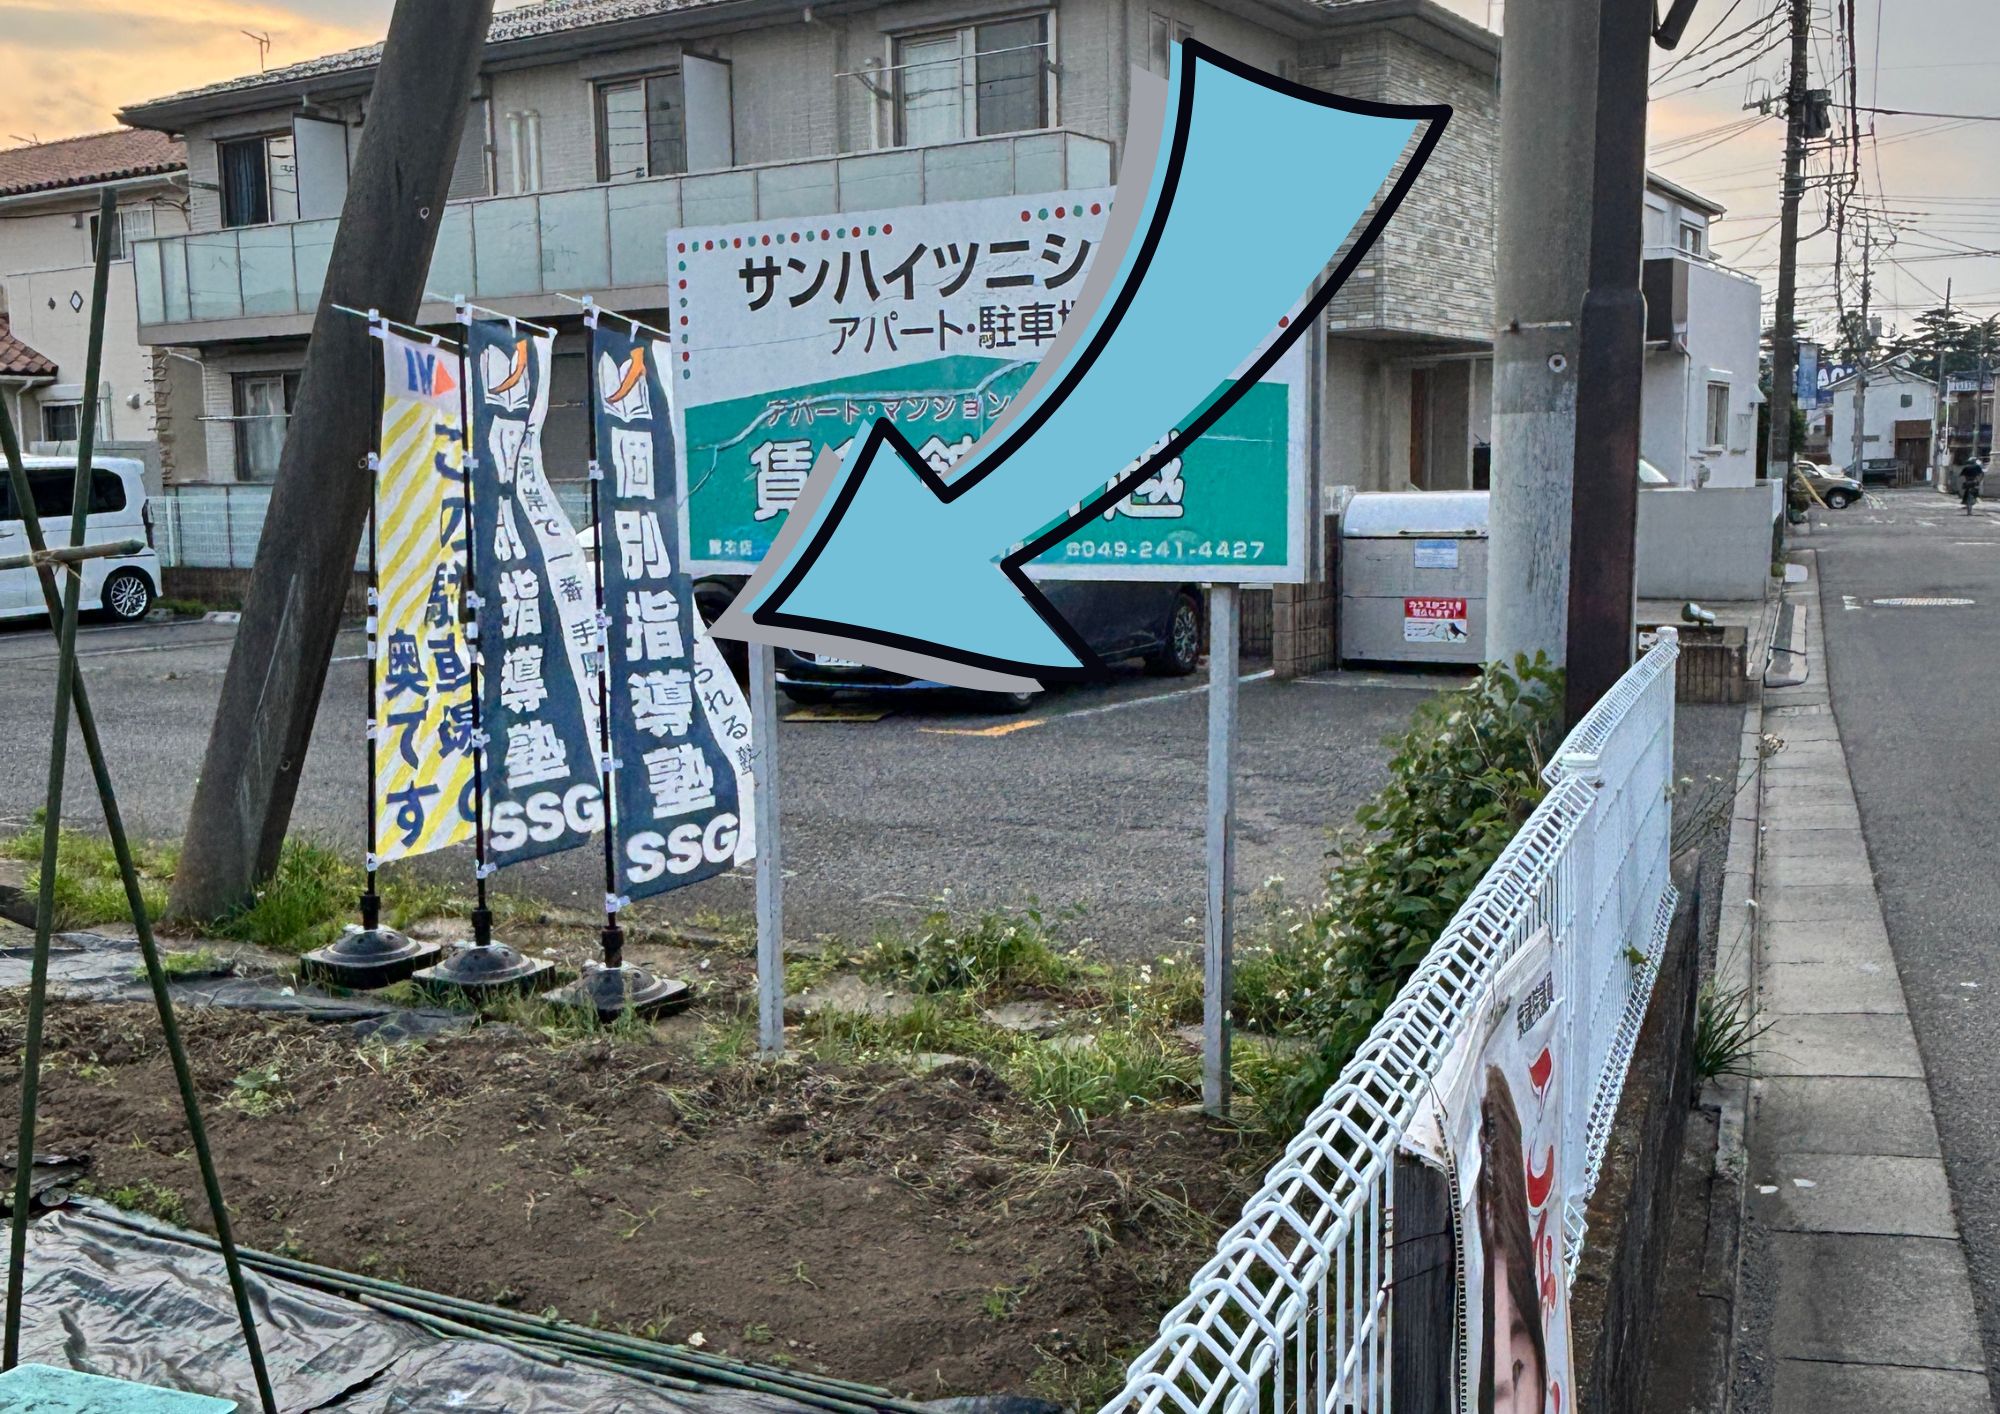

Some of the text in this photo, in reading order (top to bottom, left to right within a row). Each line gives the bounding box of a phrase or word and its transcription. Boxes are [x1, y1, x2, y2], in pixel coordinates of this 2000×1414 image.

[738, 233, 1091, 312] サンハイツニシ
[611, 427, 716, 820] 個別指導塾
[384, 627, 440, 848] 奥です
[489, 783, 605, 852] SSG
[626, 812, 739, 884] SSG
